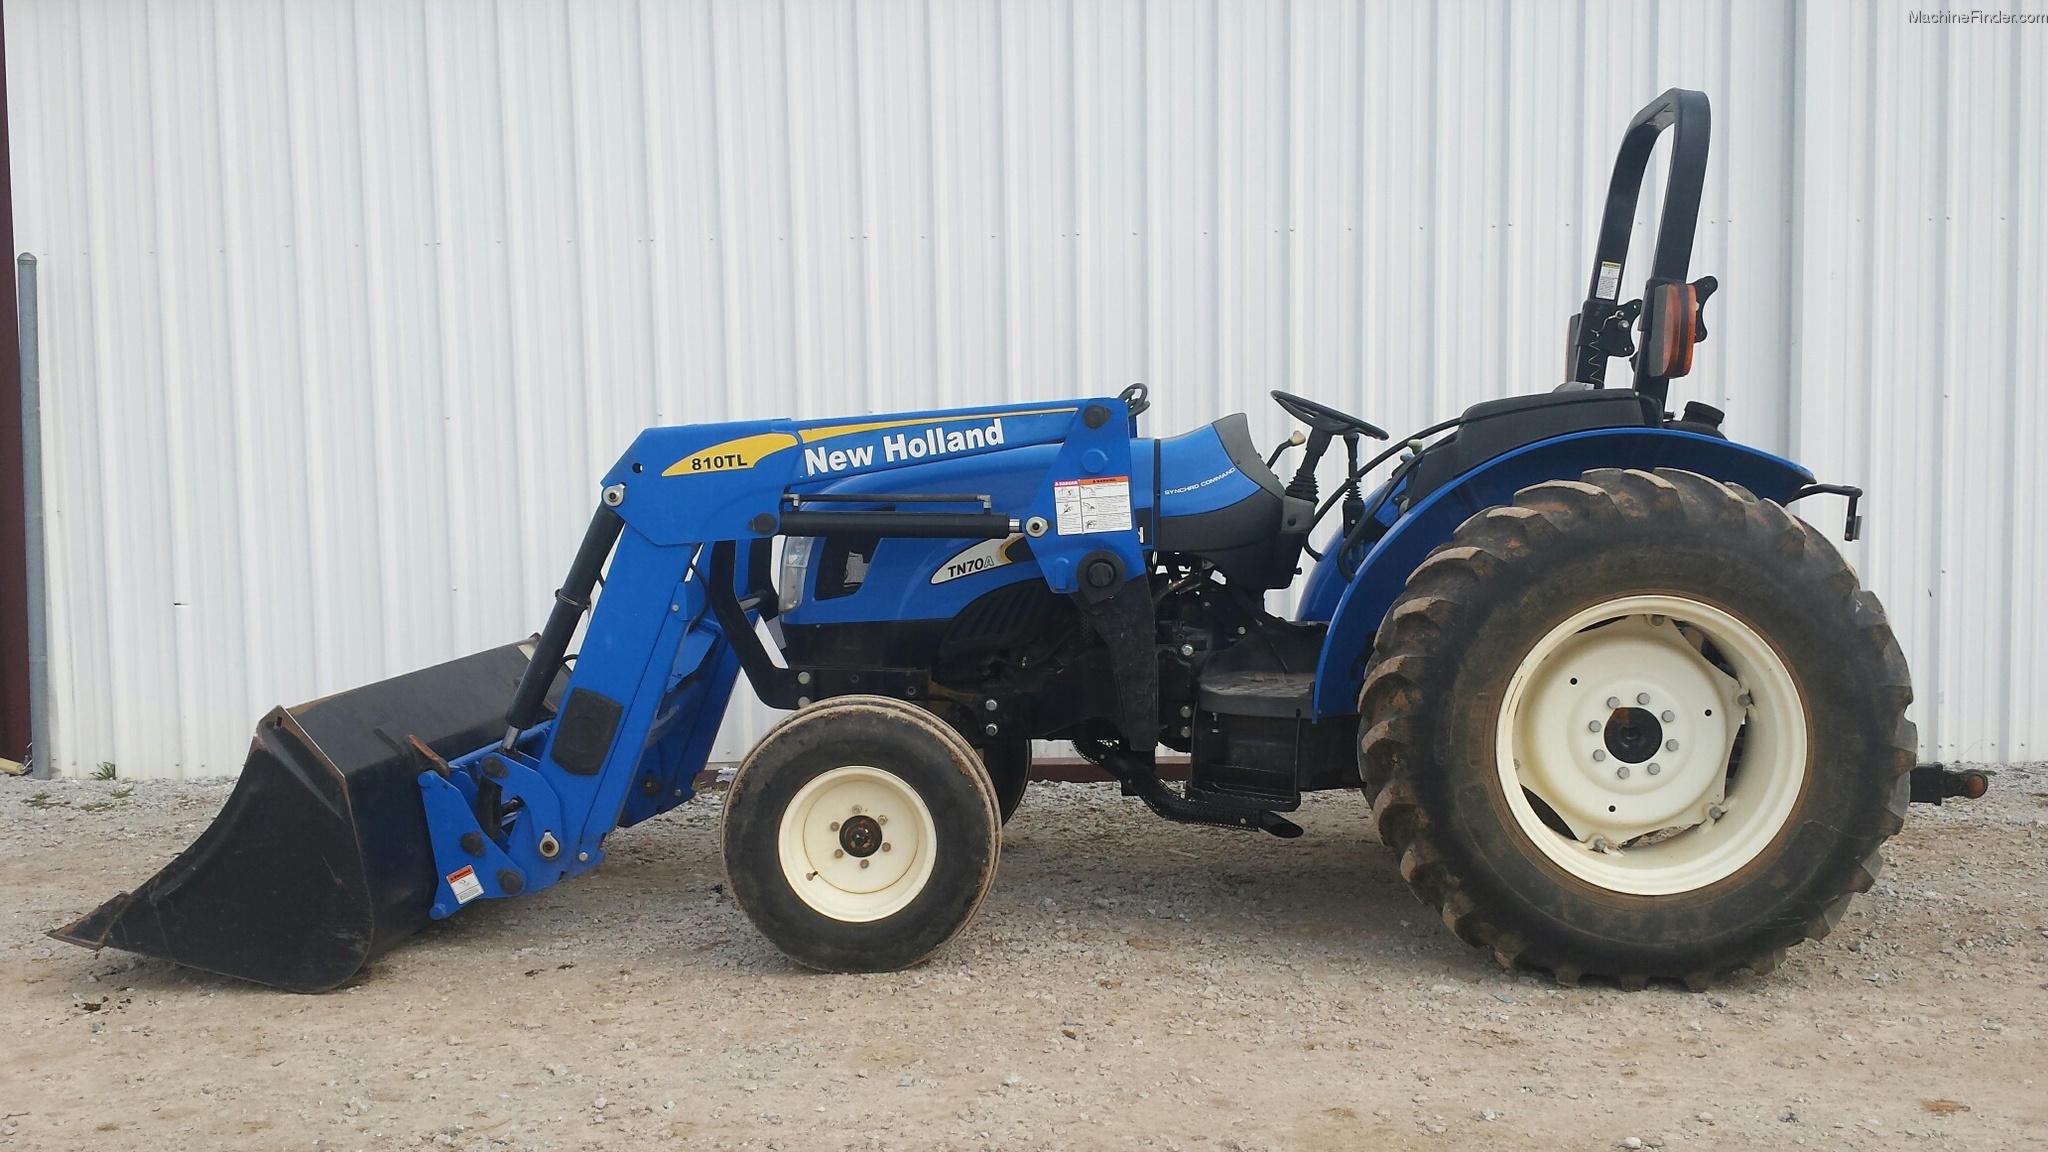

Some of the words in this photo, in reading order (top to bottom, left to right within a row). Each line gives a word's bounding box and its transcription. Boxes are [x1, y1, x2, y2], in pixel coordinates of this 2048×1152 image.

[805, 445, 873, 474] New
[884, 419, 1003, 461] Holland
[691, 454, 748, 471] 810TL
[1164, 483, 1200, 495] SYNCHRO
[1200, 467, 1236, 487] COMMAND
[948, 556, 993, 577] TN70A
